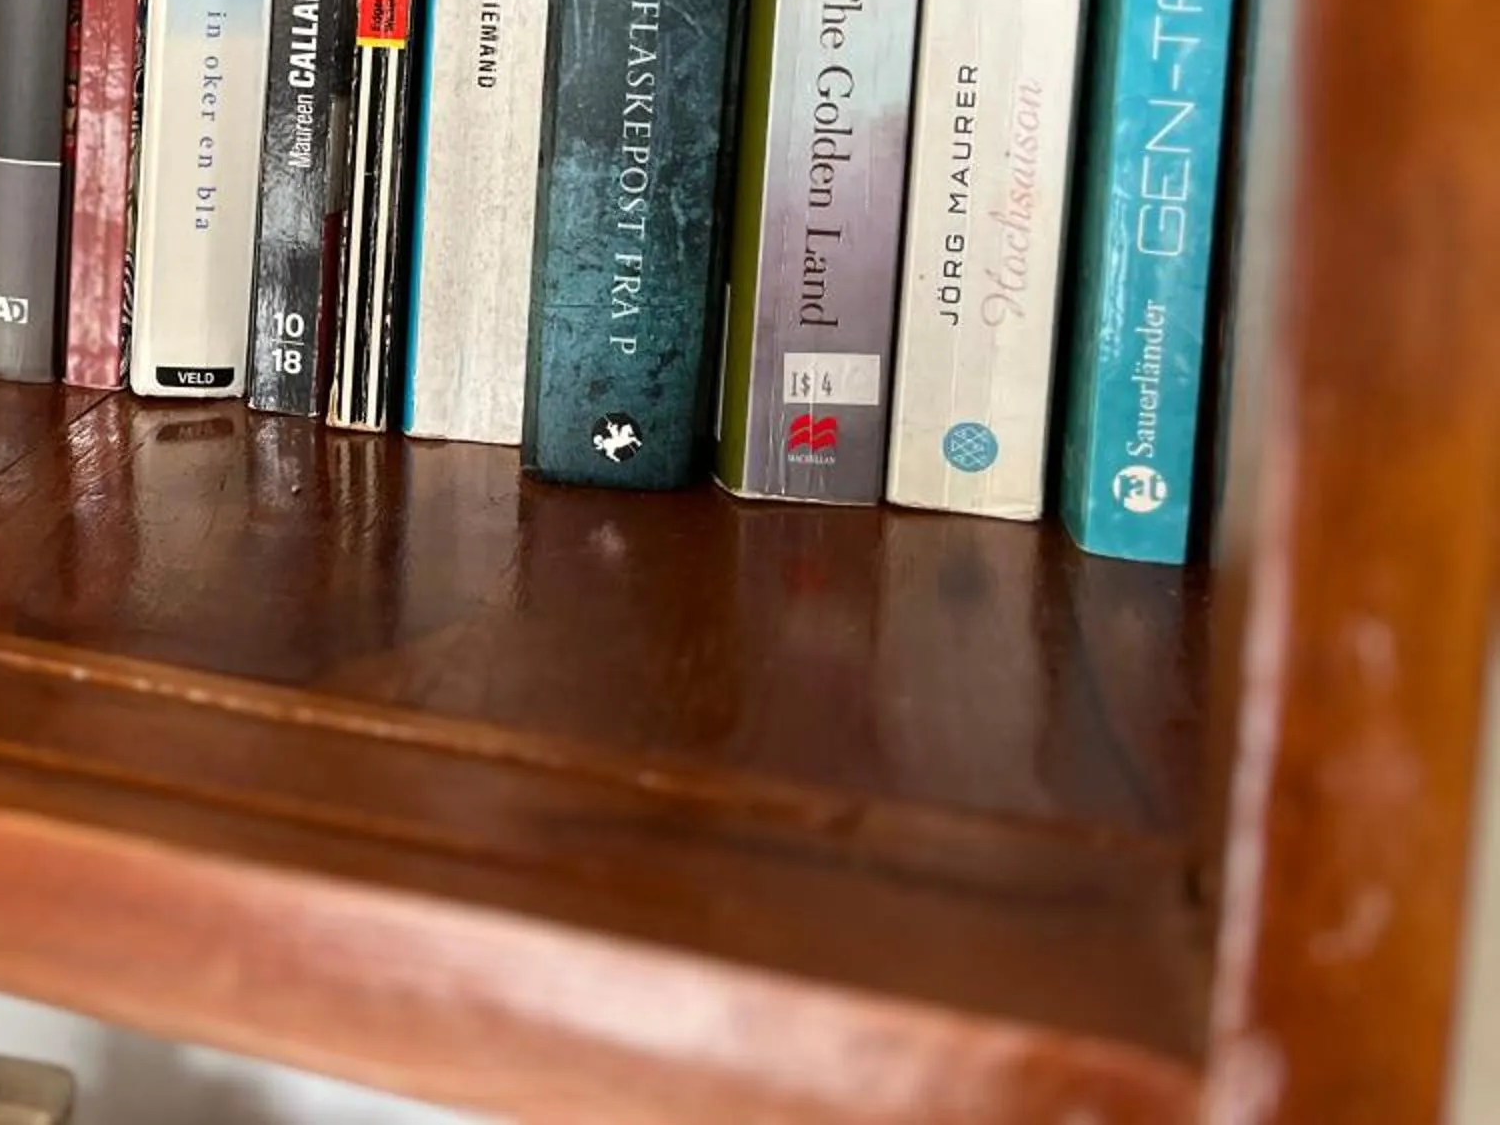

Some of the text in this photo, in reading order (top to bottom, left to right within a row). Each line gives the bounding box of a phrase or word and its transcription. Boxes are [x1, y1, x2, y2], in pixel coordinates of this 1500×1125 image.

[205, 11, 227, 38] in
[200, 56, 223, 122] oker
[197, 135, 214, 168] en
[287, 92, 315, 169] Maureen
[808, 65, 855, 209] Golden
[195, 186, 217, 230] bla
[609, 0, 660, 355] FLASKEPOST FRA P
[936, 63, 979, 326] JÖRG MAURER
[981, 78, 1045, 330] Hochsaison
[799, 228, 842, 329] Land
[272, 312, 305, 338] 10
[177, 371, 215, 384] VELD
[271, 348, 302, 375] 18
[821, 371, 833, 396] 4
[1127, 298, 1167, 458] Sauerländer
